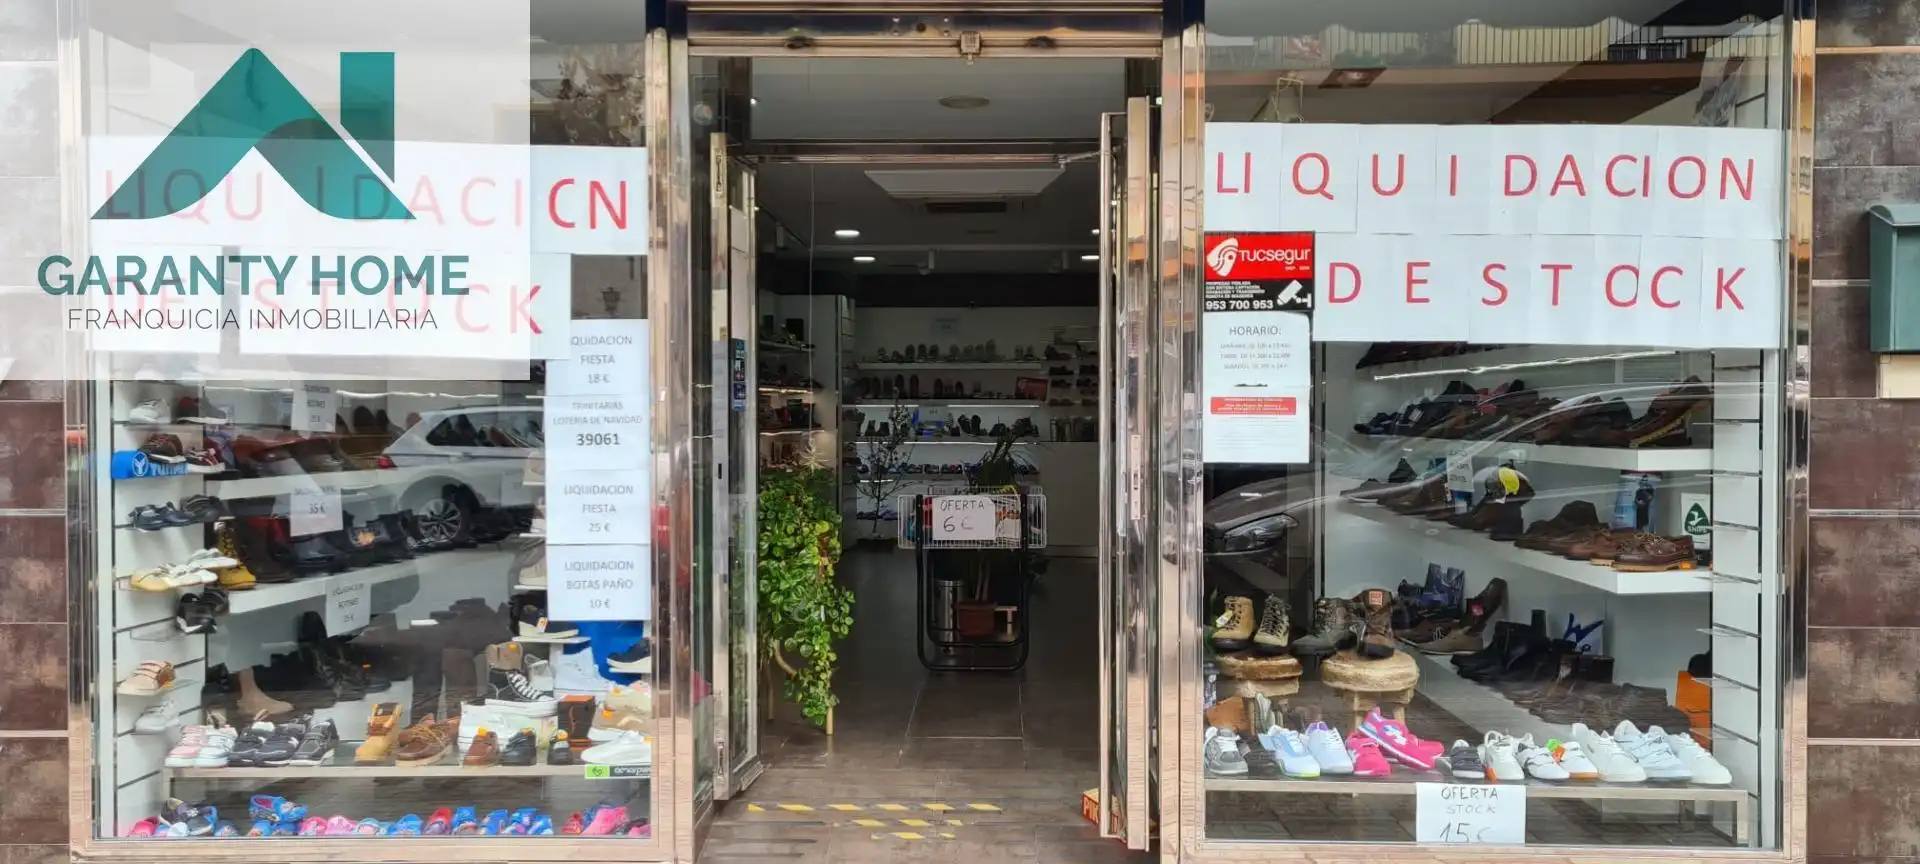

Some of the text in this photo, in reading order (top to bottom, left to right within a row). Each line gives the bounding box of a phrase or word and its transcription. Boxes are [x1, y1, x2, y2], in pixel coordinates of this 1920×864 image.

[1216, 151, 1756, 201] LIQUIDACION
[1327, 261, 1746, 310] DE STOCK
[107, 275, 542, 335] DE STOCK
[1205, 300, 1274, 310] 953 700 953
[580, 354, 616, 365] FIESTA
[575, 433, 621, 446] 39061
[563, 484, 634, 496] LIQUIDACION
[582, 503, 617, 513] FIESTA
[940, 499, 985, 511] OFERTA
[588, 522, 601, 532] 25
[943, 516, 956, 533] 6
[564, 560, 634, 572] LIQUIDACION
[566, 578, 634, 589] BOTAS PAÑO
[590, 598, 602, 608] 10
[1440, 786, 1499, 800] OFERTA
[1446, 804, 1496, 815] STOCK
